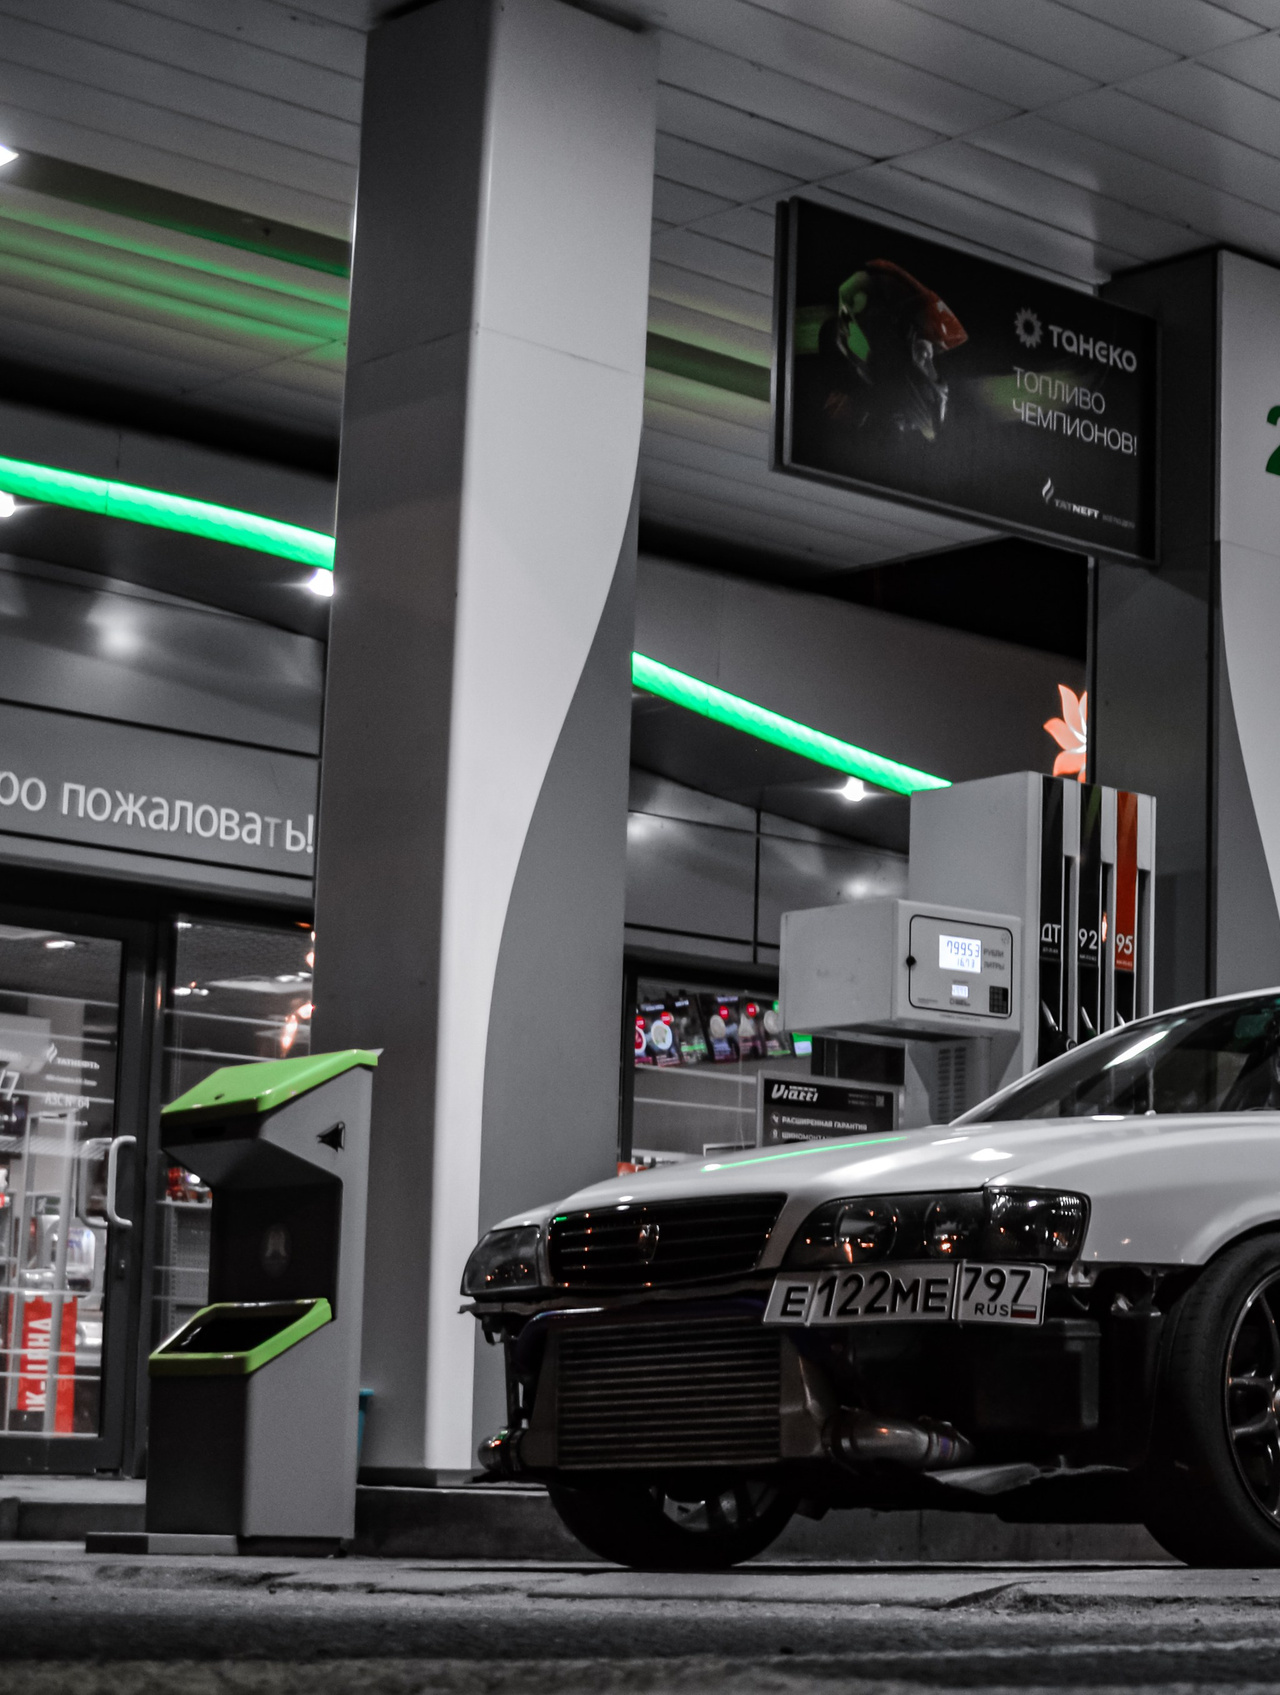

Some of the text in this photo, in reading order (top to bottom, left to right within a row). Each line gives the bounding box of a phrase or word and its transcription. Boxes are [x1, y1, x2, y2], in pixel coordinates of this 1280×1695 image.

[1013, 366, 1105, 414] ТОПЛИВО
[1012, 398, 1137, 456] ЧЕМПИОНОВ!
[1055, 499, 1100, 519] TATNEFT
[61, 782, 314, 854] пожаловать!
[1041, 923, 1061, 943] ДТ
[1078, 928, 1098, 950] 92
[1116, 933, 1133, 955] 95
[771, 1083, 819, 1103] Viatti
[781, 1115, 868, 1131] РАСШИРЕННАЯ ГАРАНТИЯ
[962, 1266, 1032, 1304] 797
[974, 1302, 1010, 1318] RUS
